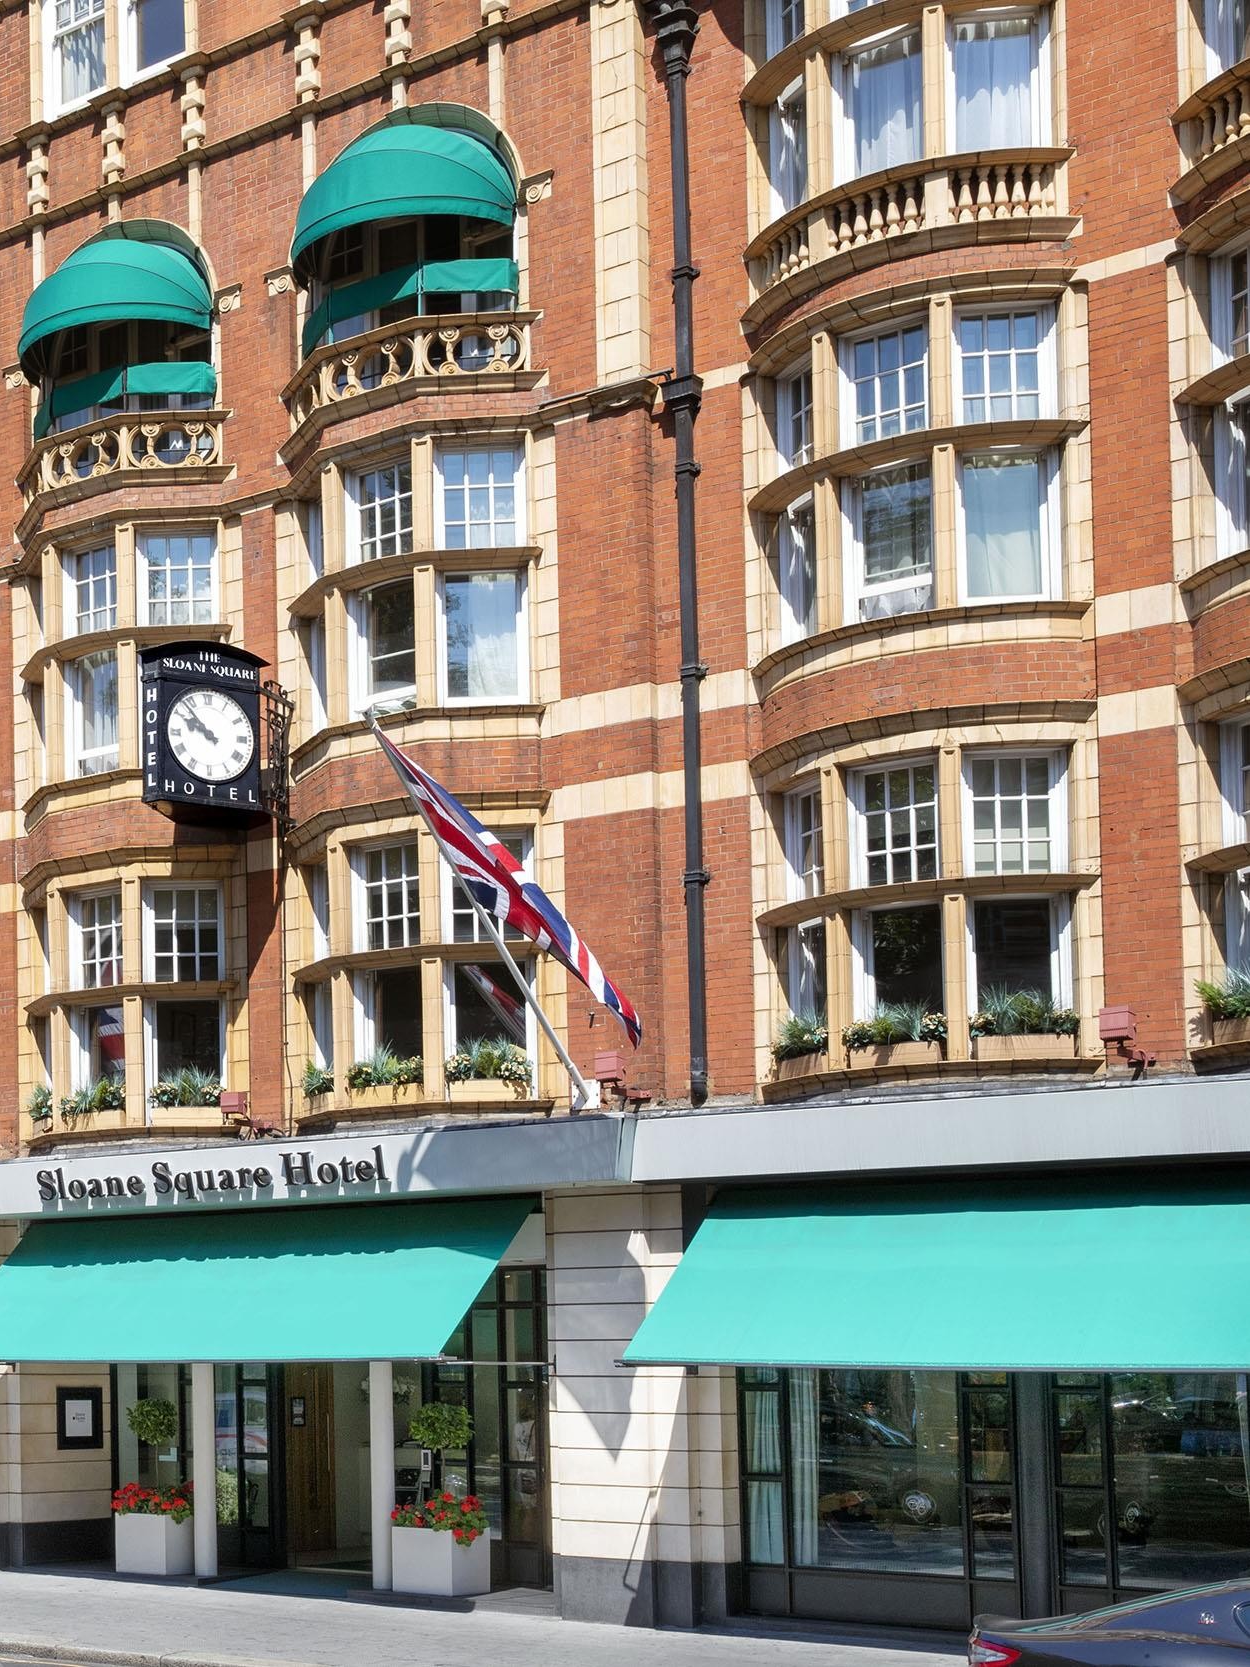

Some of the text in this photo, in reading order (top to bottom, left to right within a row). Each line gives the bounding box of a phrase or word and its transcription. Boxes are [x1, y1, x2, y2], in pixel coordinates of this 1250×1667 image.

[199, 651, 221, 663] THE
[210, 664, 257, 680] SQUARE
[146, 688, 158, 787] HOTEL
[164, 779, 257, 803] HOTEL
[36, 1144, 389, 1200] Sloane Square Hotel
